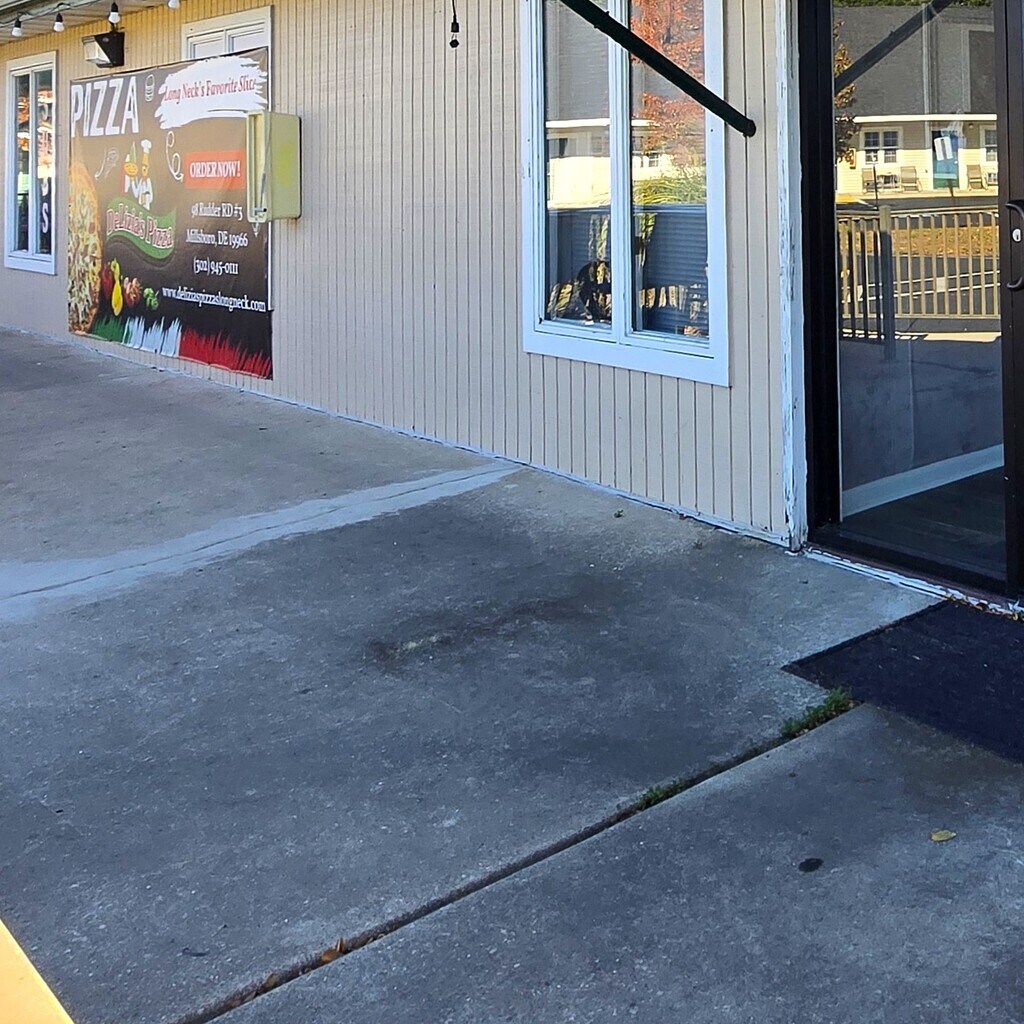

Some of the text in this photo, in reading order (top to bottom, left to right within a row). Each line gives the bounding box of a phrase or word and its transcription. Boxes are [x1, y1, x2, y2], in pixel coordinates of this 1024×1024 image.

[164, 86, 180, 104] Long
[180, 80, 206, 100] Neck's
[206, 77, 237, 98] Favorite
[71, 76, 139, 137] PIZZA
[189, 159, 241, 178] ORDER NOW!
[199, 202, 221, 218] Rudder
[221, 203, 233, 218] RD
[145, 217, 174, 250] Pizza
[186, 228, 248, 249] Millsboro, DE 19966
[193, 255, 239, 276] (302) 945-0111
